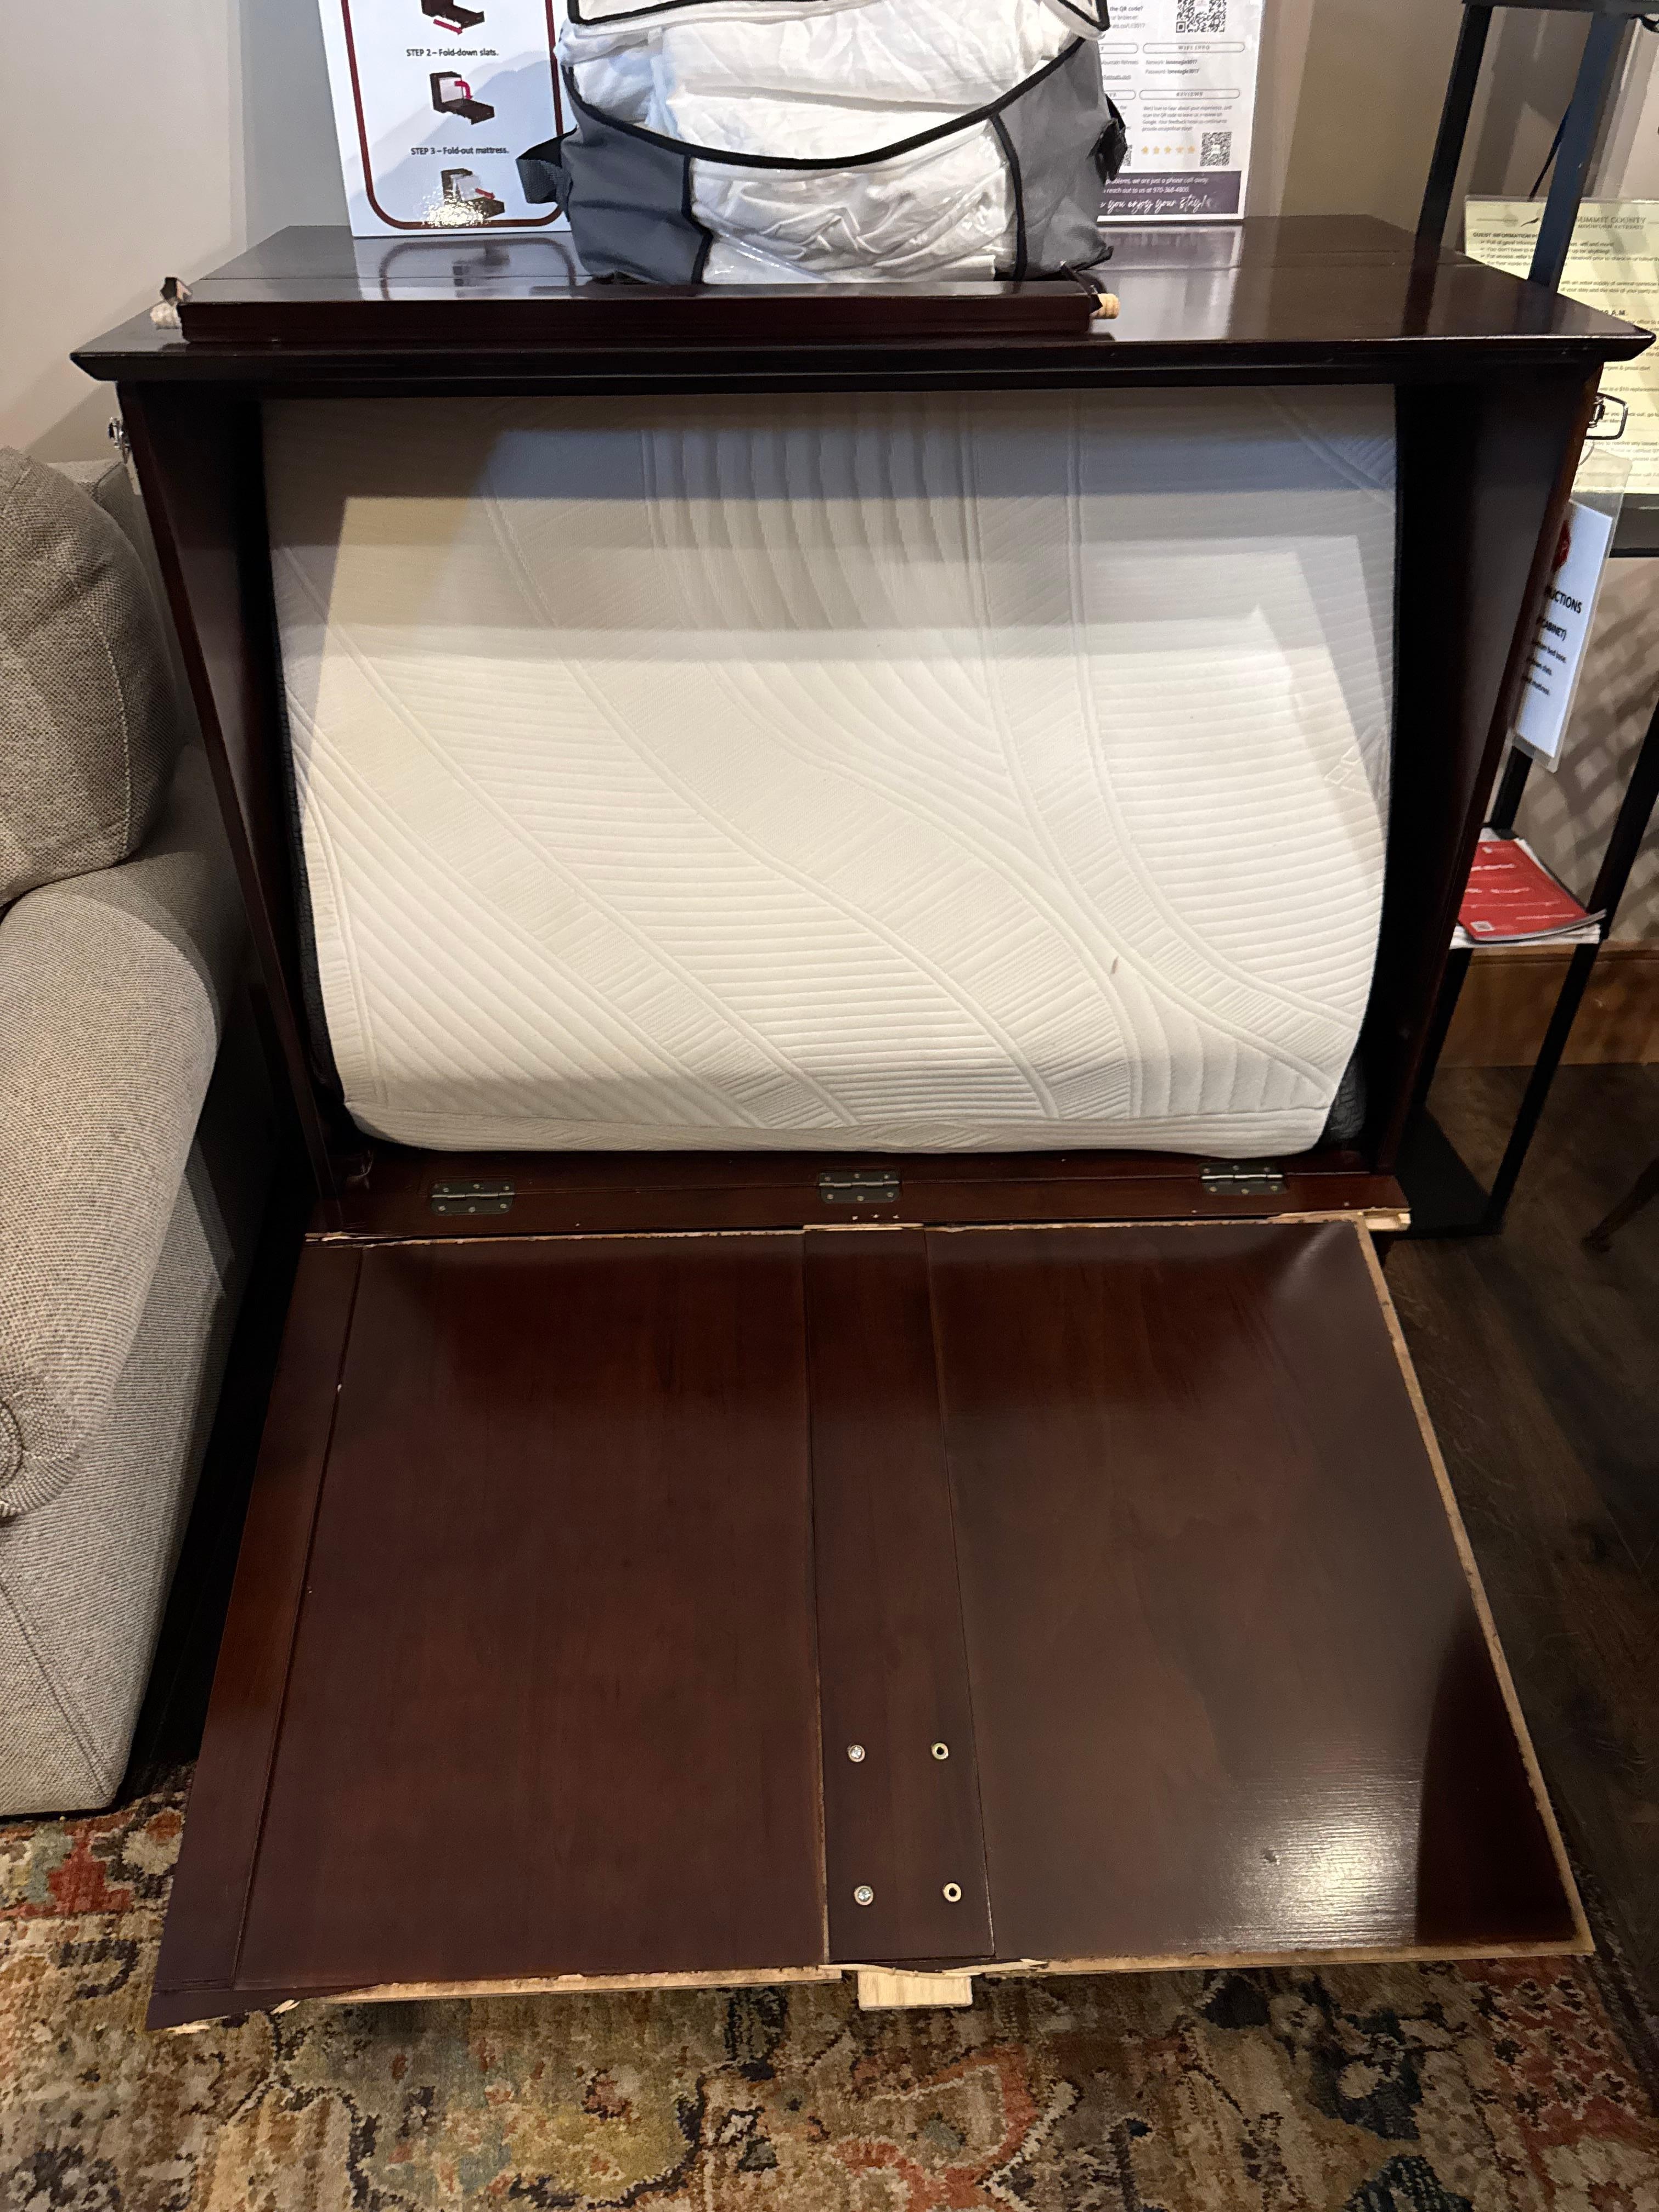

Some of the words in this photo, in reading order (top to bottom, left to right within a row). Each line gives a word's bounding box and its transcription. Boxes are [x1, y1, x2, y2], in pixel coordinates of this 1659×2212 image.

[438, 48, 478, 57] Fold-down
[479, 48, 499, 57] slats.
[1127, 199, 1153, 215] enjoy
[1155, 199, 1176, 215] your
